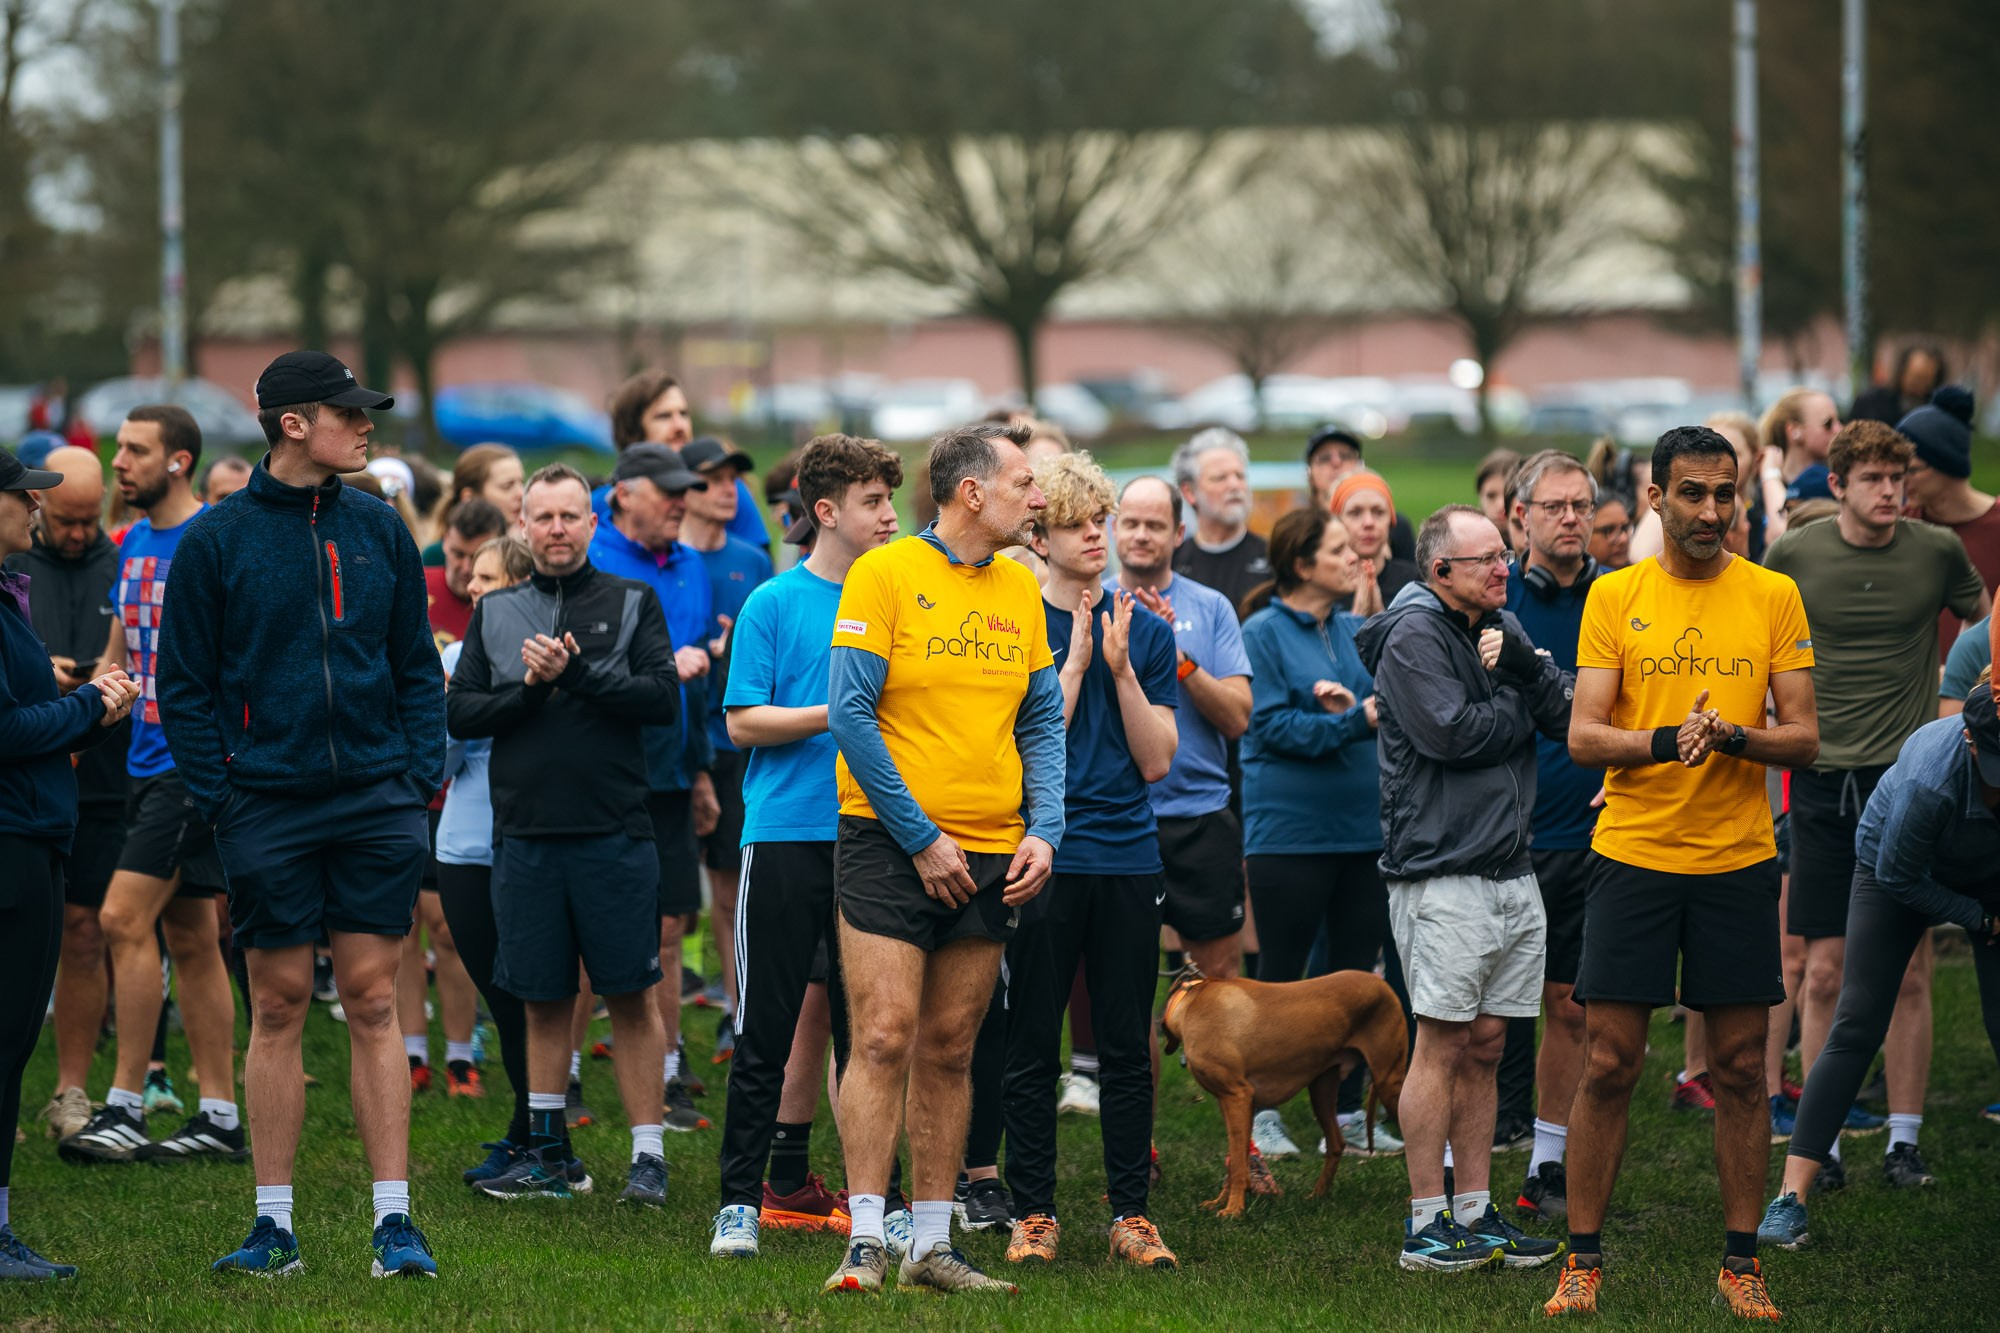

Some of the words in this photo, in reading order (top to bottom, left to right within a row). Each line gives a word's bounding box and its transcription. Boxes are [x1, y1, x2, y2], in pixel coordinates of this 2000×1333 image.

[987, 613, 1020, 640] Vitality
[926, 628, 1024, 664] parkrun
[982, 667, 1026, 678] bournemo
[1640, 644, 1753, 682] parkrun
